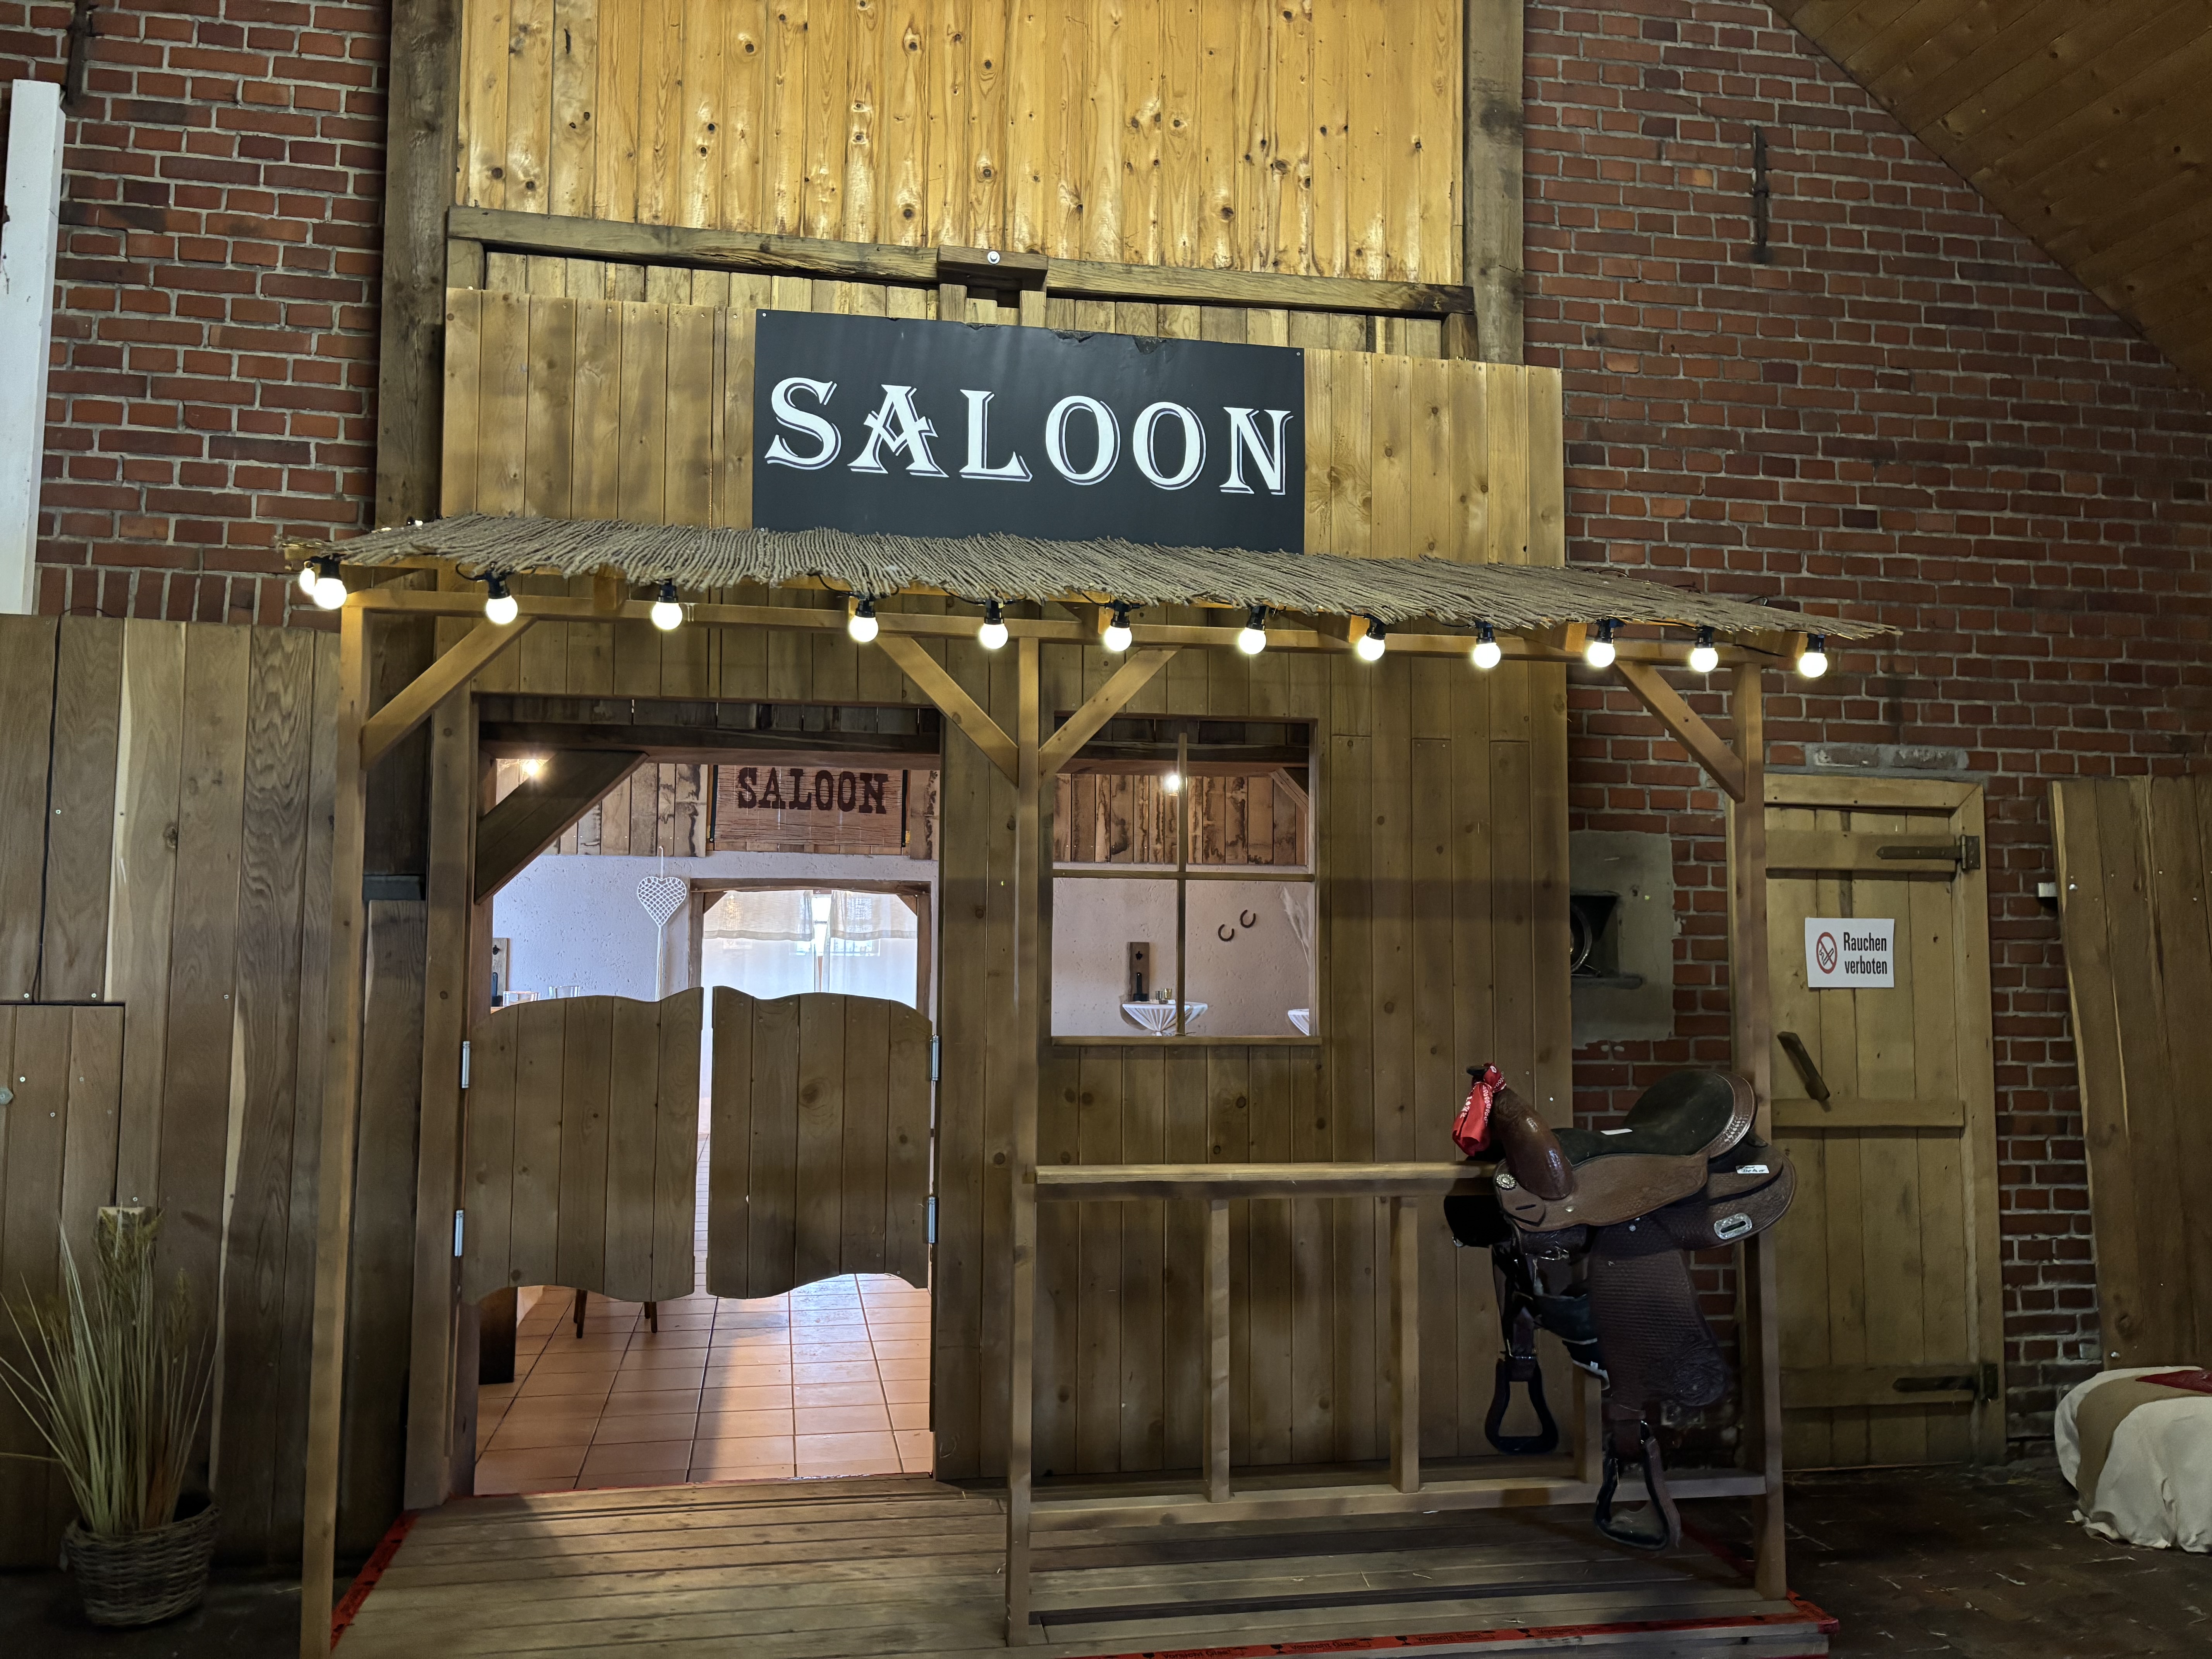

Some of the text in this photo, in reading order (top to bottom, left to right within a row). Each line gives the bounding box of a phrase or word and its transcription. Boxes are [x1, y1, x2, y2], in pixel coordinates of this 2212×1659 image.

[764, 377, 1294, 496] SALOON
[738, 767, 888, 814] SALOON
[1843, 932, 1887, 951] Rauchen
[1844, 955, 1887, 974] verboten
